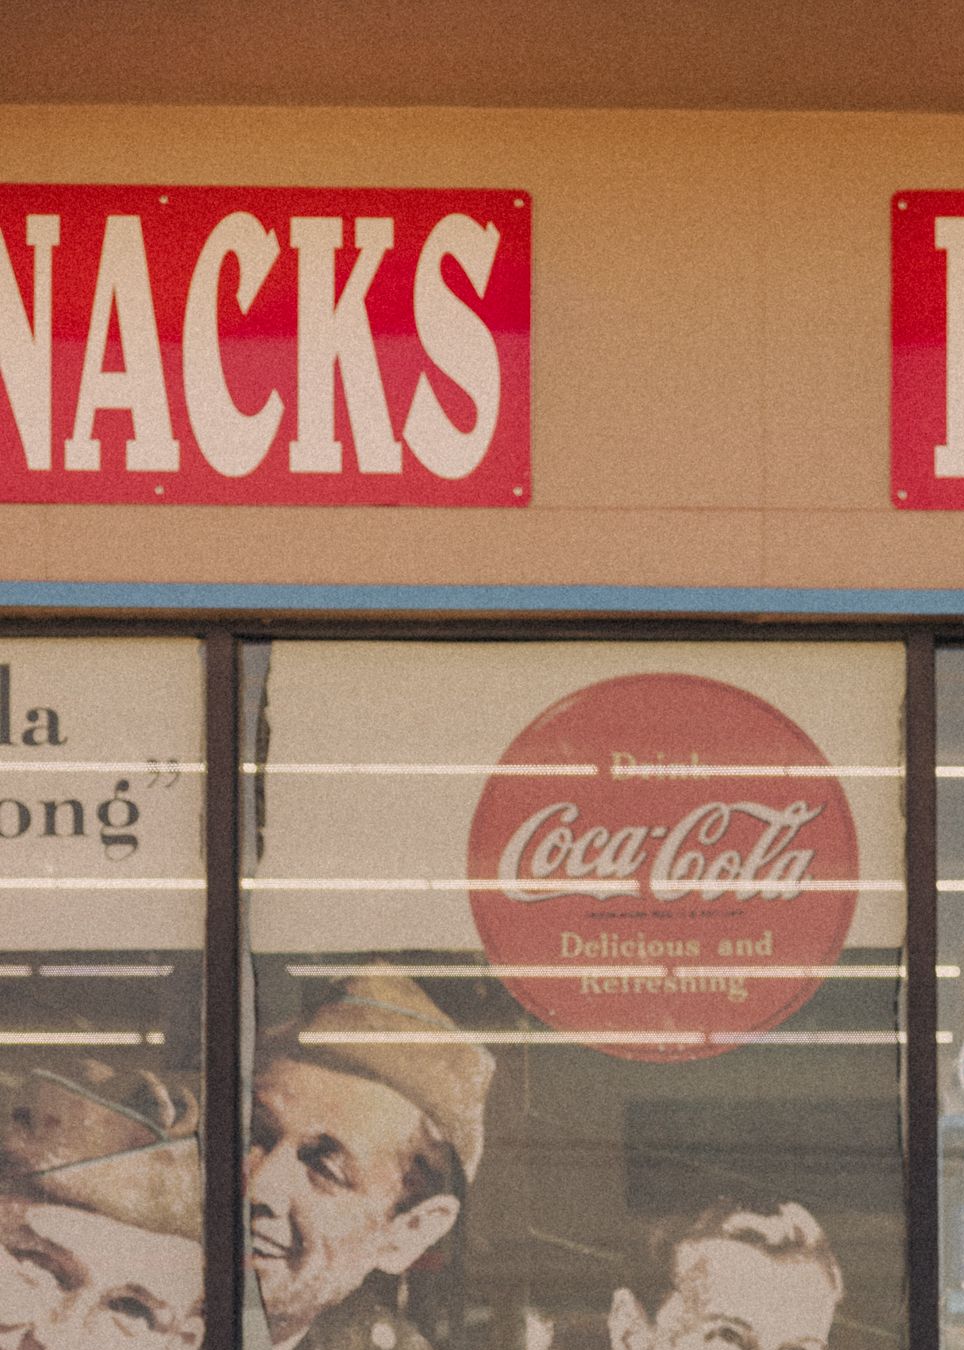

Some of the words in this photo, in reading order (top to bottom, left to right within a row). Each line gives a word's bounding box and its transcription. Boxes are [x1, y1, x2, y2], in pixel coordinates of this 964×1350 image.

[0, 212, 501, 479] NACKS
[498, 802, 826, 902] Coca-Cola
[561, 931, 699, 959] Delicious
[718, 931, 773, 957] and
[580, 967, 749, 1002] Refreshing
